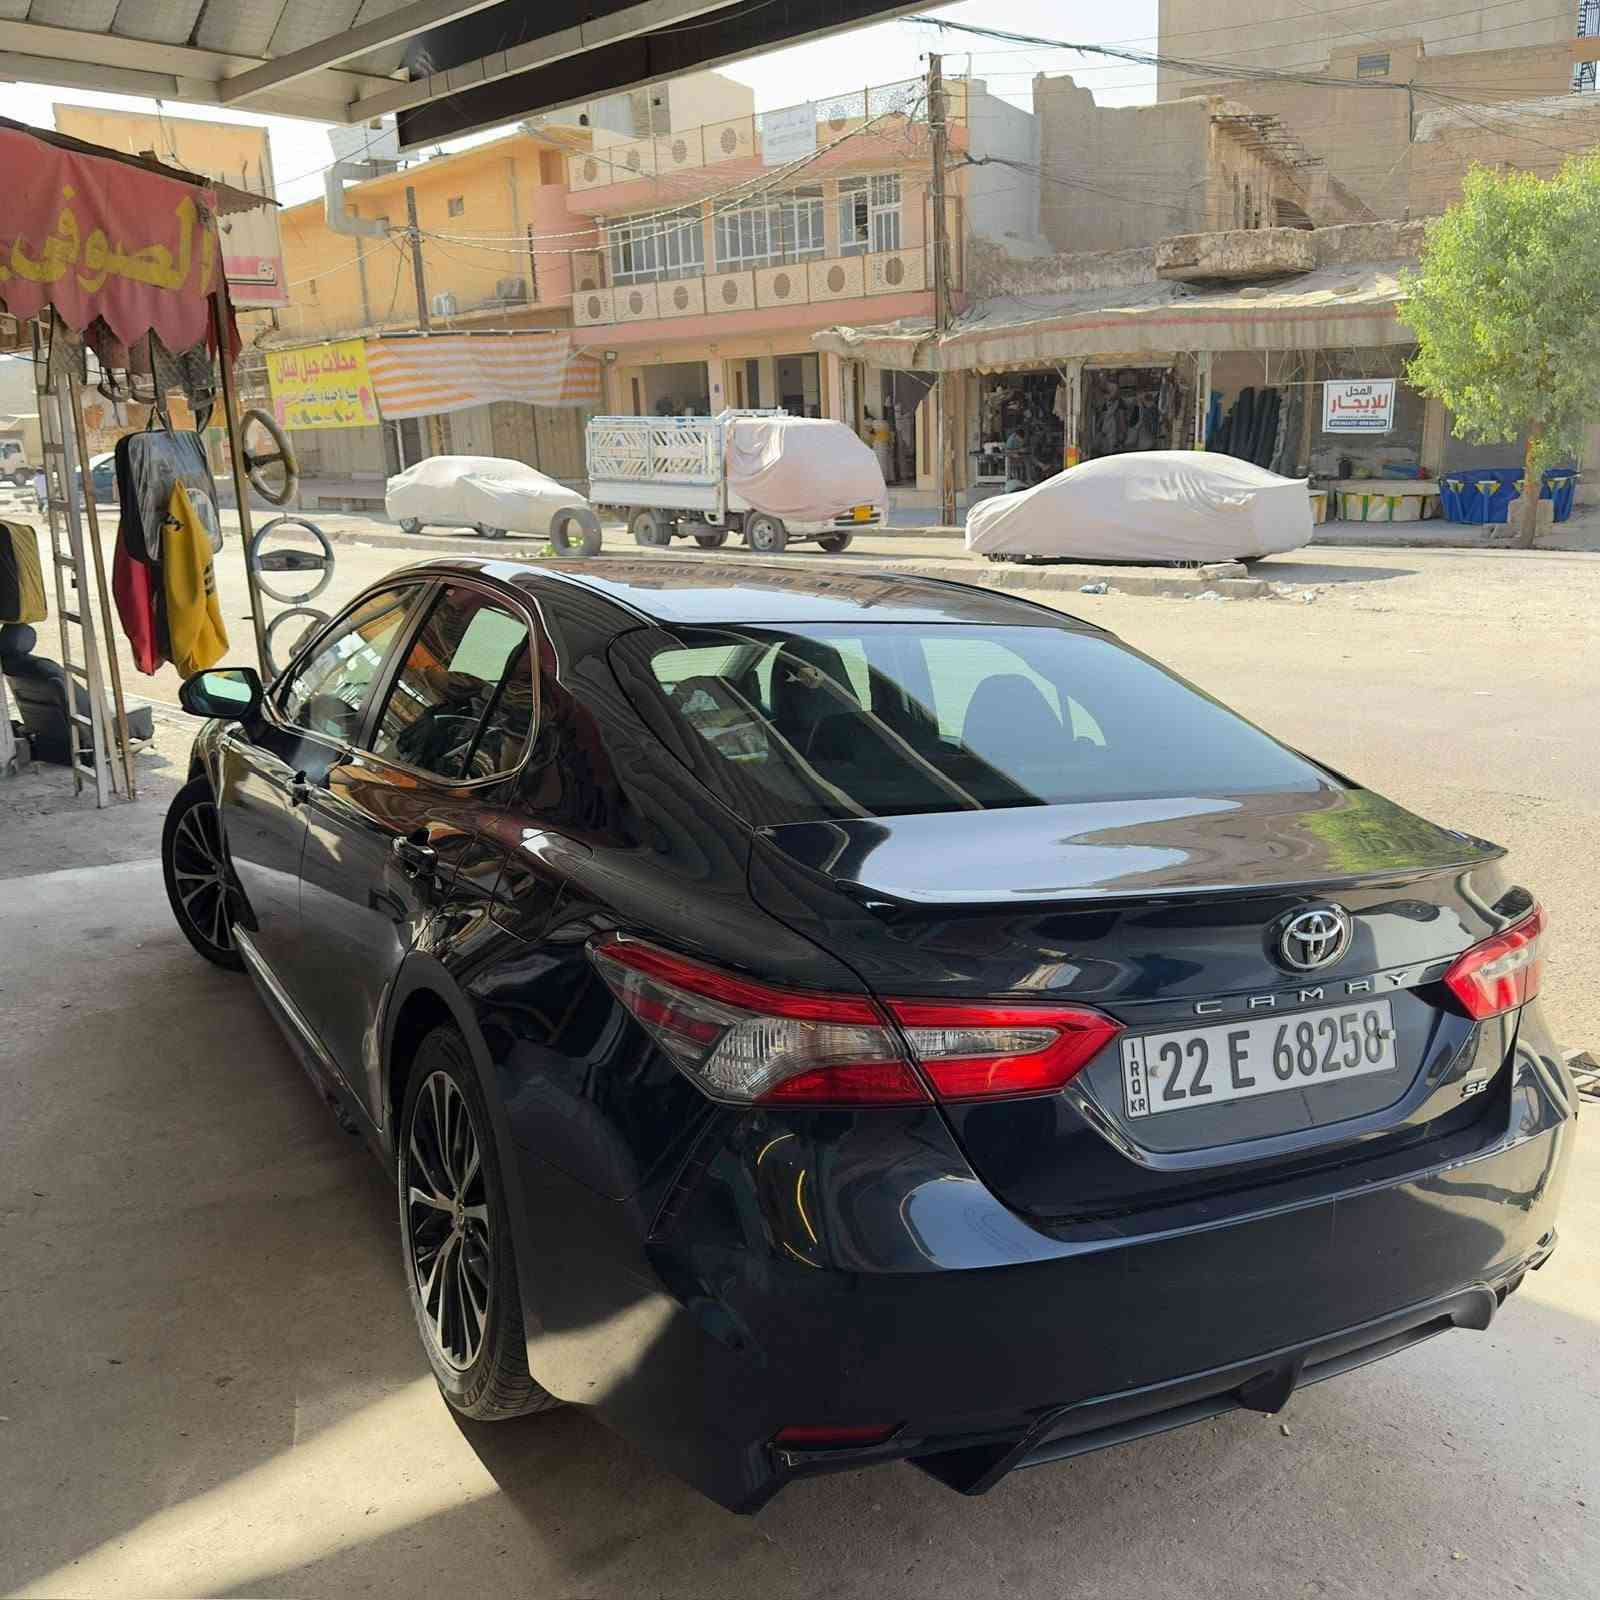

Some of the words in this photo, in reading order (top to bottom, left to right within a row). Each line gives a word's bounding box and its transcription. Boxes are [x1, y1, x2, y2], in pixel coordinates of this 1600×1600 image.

[1346, 386, 1372, 397] المحل
[1331, 394, 1388, 414] للإيجار
[1194, 973, 1408, 1014] CAMRY
[1159, 1041, 1213, 1101] 22
[1227, 1030, 1256, 1089] E
[1272, 1009, 1386, 1081] 68258
[1463, 1080, 1489, 1098] SE
[1130, 1098, 1146, 1113] KR
